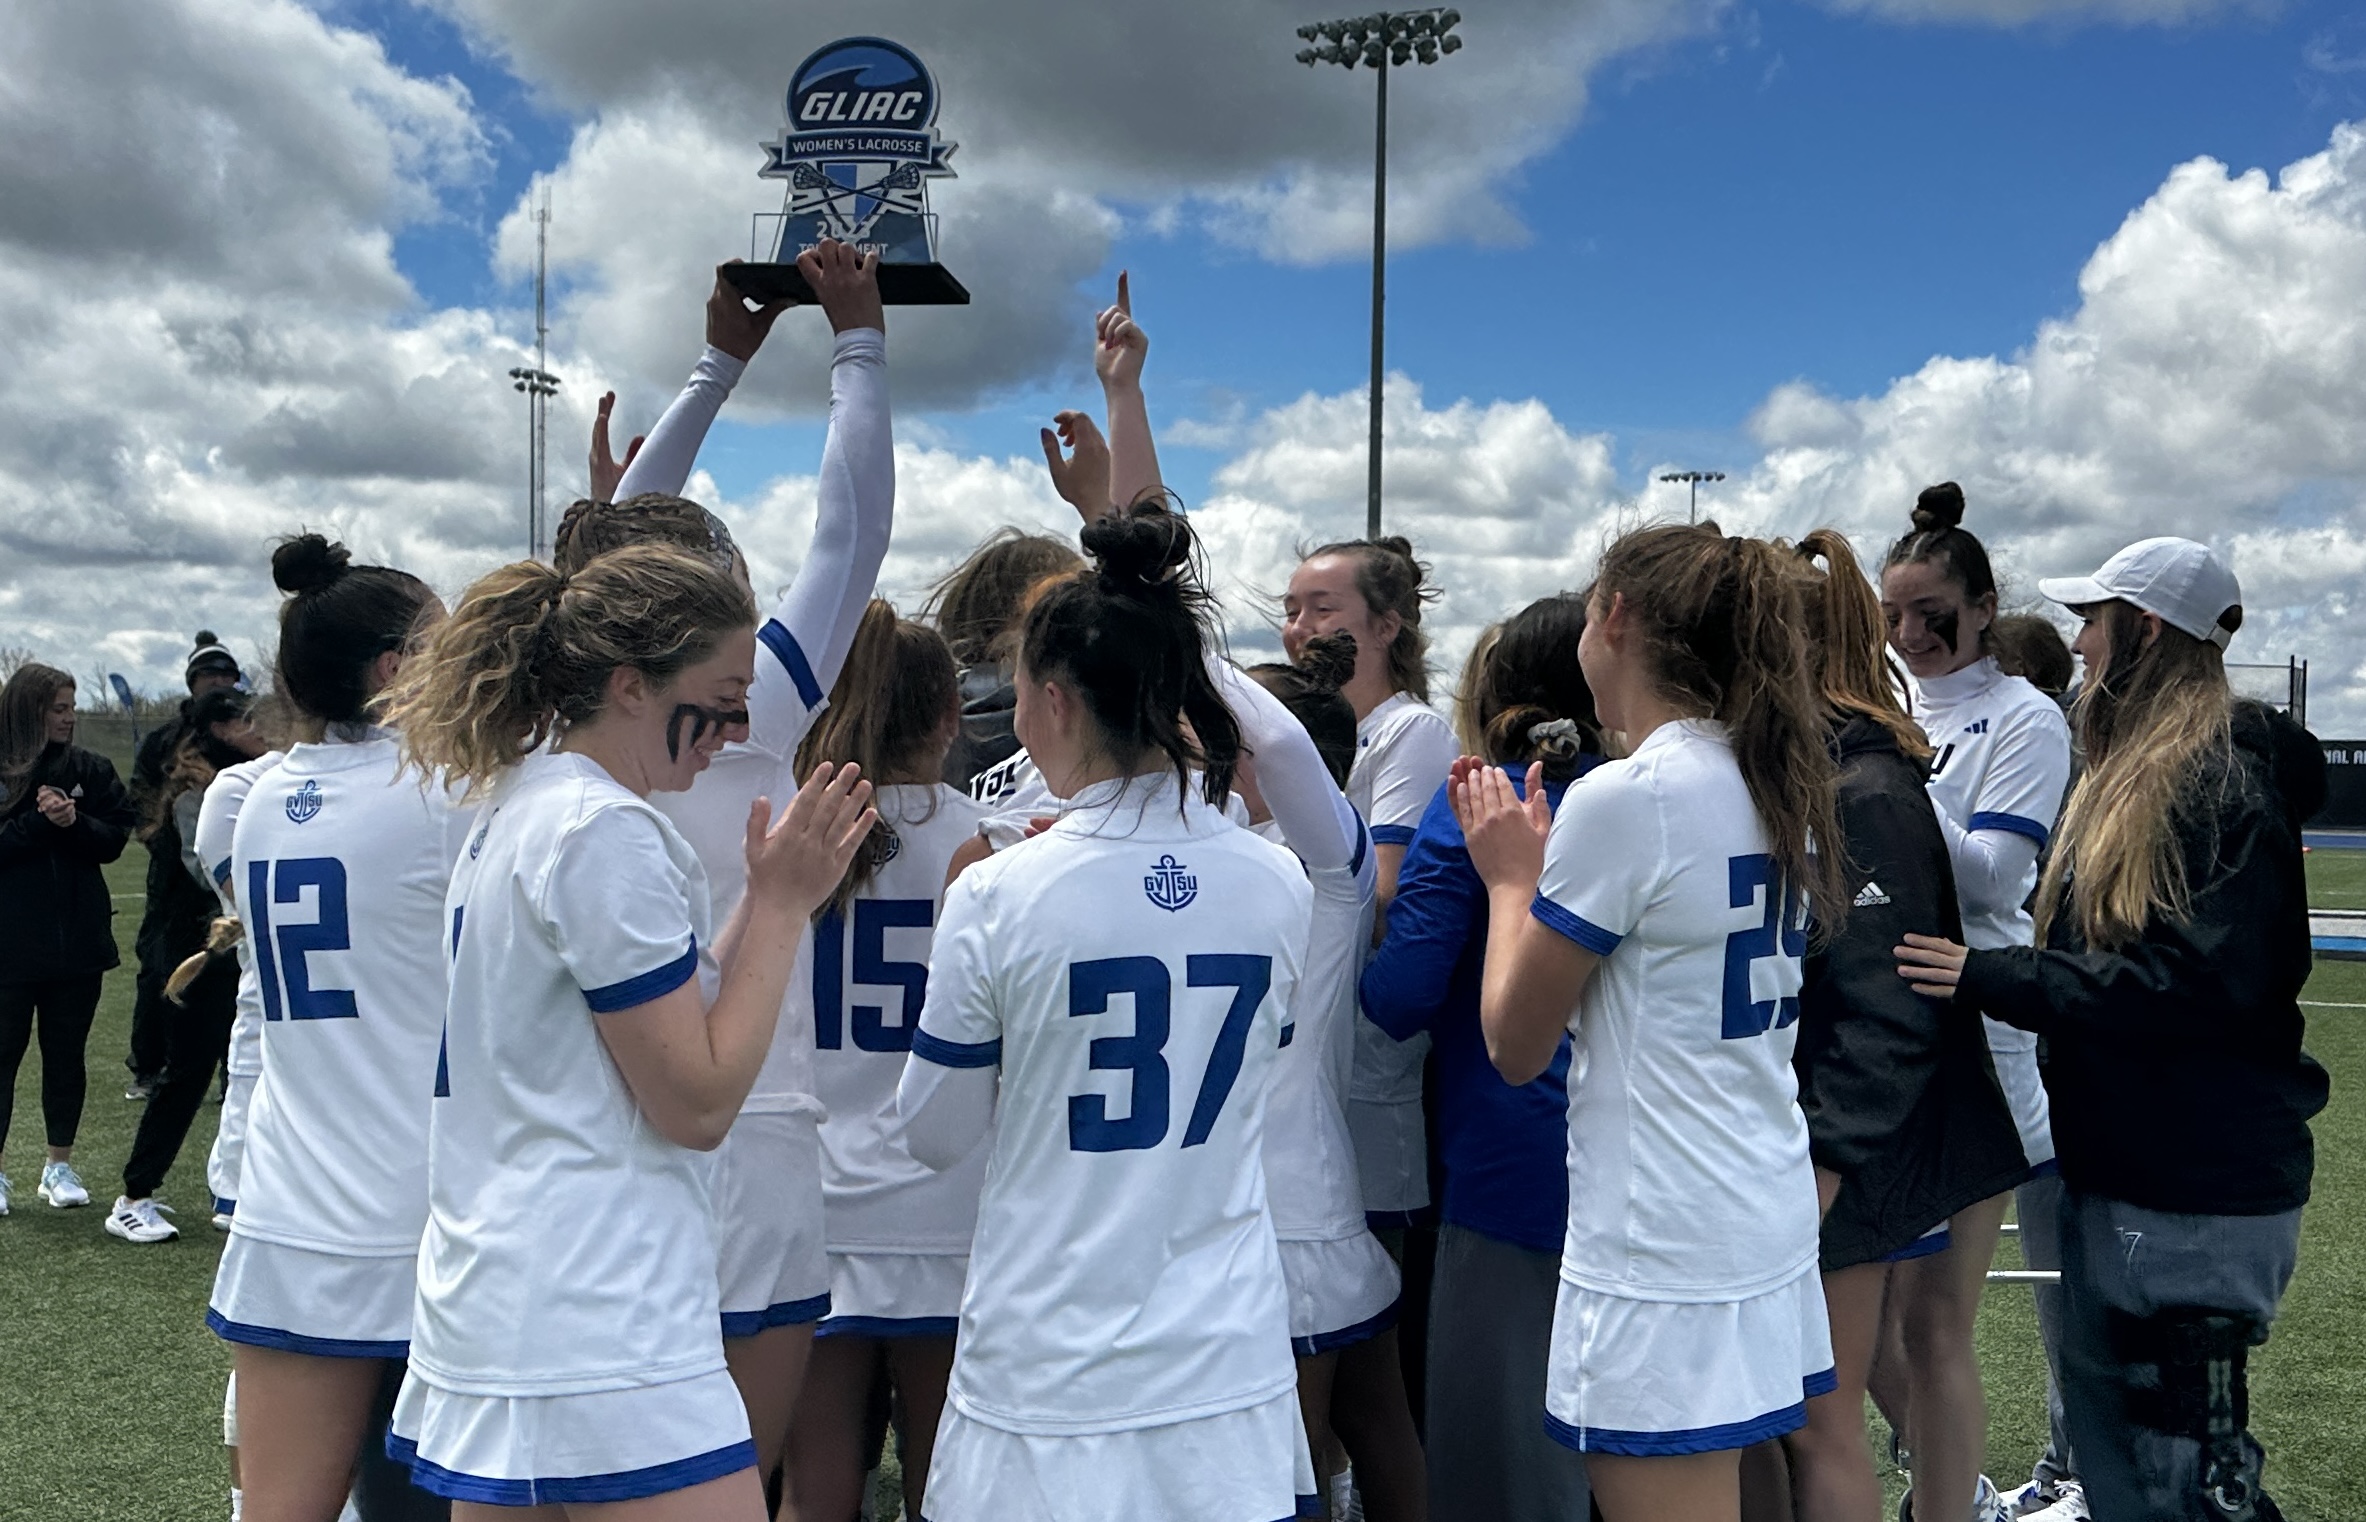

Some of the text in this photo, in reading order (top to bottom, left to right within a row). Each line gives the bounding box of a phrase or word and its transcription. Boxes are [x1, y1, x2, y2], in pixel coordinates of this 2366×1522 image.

[792, 138, 923, 153] WOMEN'S LACROSSE
[800, 91, 923, 121] GLIAC
[248, 857, 360, 1021] 12
[1853, 895, 1891, 907] adidas
[812, 899, 935, 1053] 15
[1068, 953, 1273, 1152] 37
